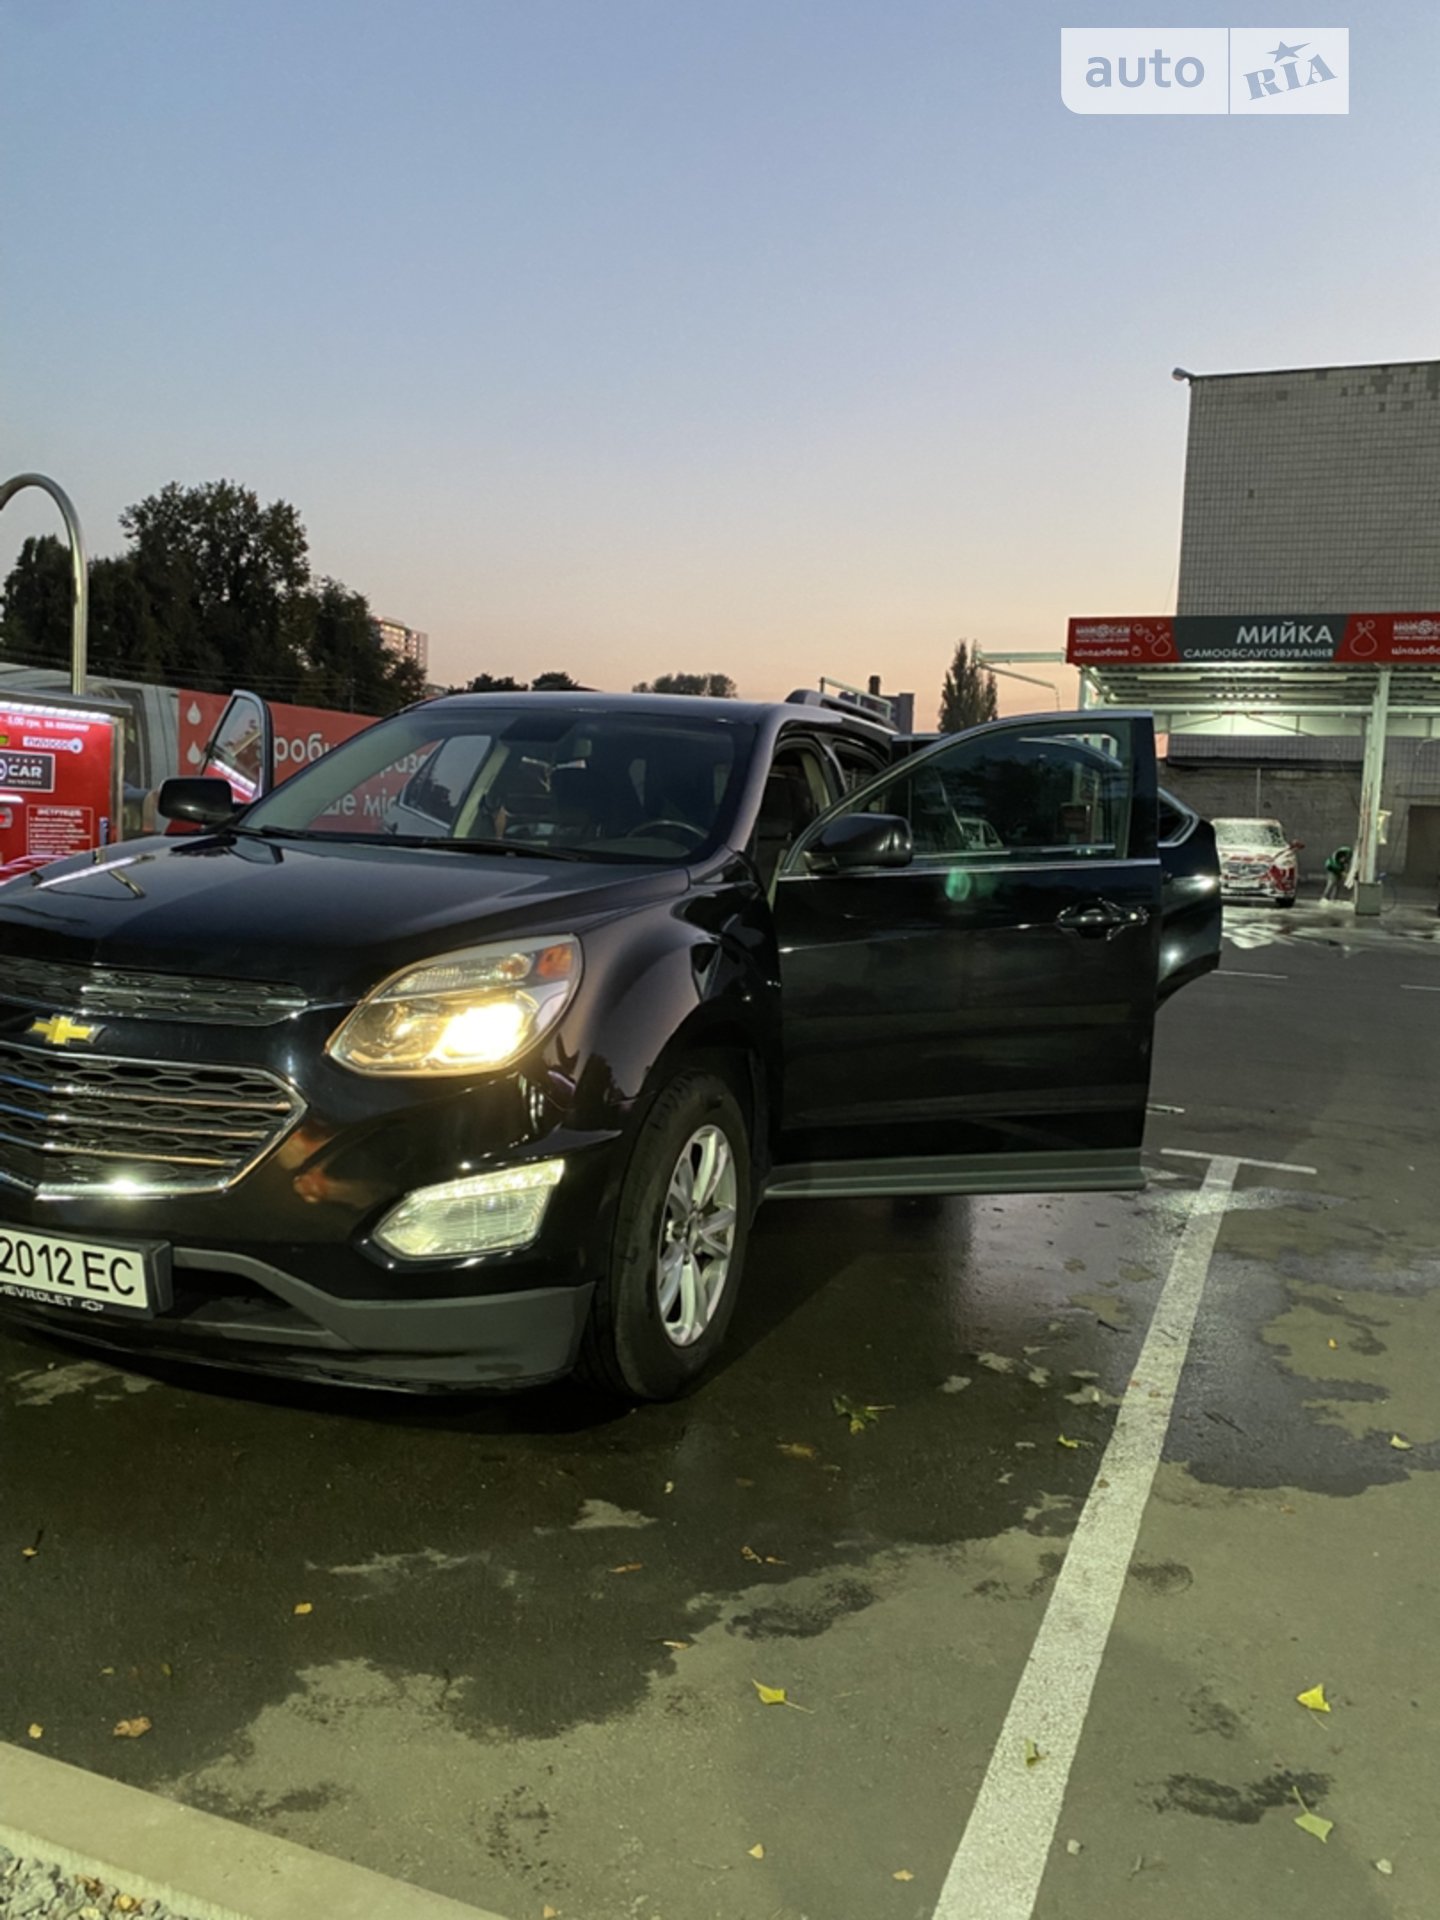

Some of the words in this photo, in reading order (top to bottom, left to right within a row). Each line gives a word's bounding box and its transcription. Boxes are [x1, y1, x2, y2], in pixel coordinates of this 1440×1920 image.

[1236, 621, 1334, 644] МИЙКА
[1183, 648, 1334, 658] САМООБСЛУГОВУВАННЯ
[8, 764, 43, 778] CAR
[0, 1237, 75, 1286] 2012
[82, 1251, 134, 1296] EC
